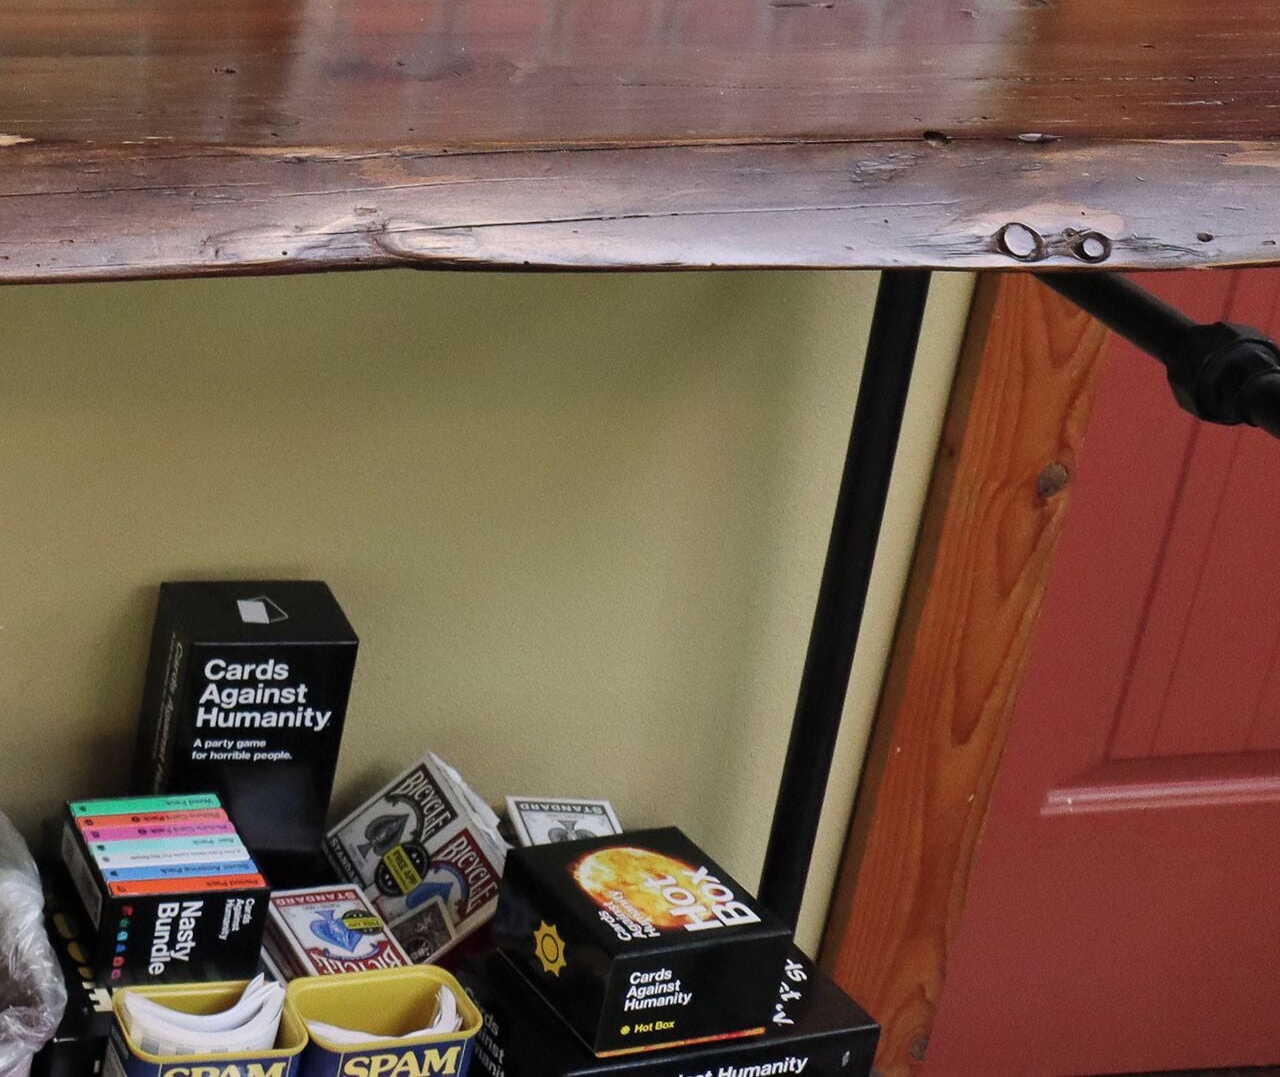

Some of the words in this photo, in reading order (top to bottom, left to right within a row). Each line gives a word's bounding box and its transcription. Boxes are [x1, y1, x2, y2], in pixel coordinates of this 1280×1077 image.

[204, 658, 290, 681] Cards
[198, 683, 309, 709] Against
[195, 707, 332, 732] Humanity
[192, 751, 208, 760] for
[209, 751, 251, 760] horrible
[253, 751, 293, 762] people.
[193, 738, 202, 748] A
[204, 739, 235, 750] party
[236, 740, 267, 749] game
[393, 769, 452, 843] BICYCLE
[520, 802, 604, 816] STANDARD
[438, 834, 499, 918] BICYCLE
[273, 890, 357, 906] STANDARD
[644, 874, 718, 932] Hot
[689, 865, 762, 927] Box
[241, 897, 255, 925] Cards
[171, 900, 204, 962] Nasty
[599, 909, 632, 942] Cards
[148, 902, 180, 975] Bundle
[629, 967, 673, 985] Cards
[626, 979, 682, 999] Against
[624, 992, 692, 1012] Humanity
[634, 1022, 653, 1034] Hot
[655, 1020, 675, 1031] Box
[343, 1046, 462, 1077] SPAM
